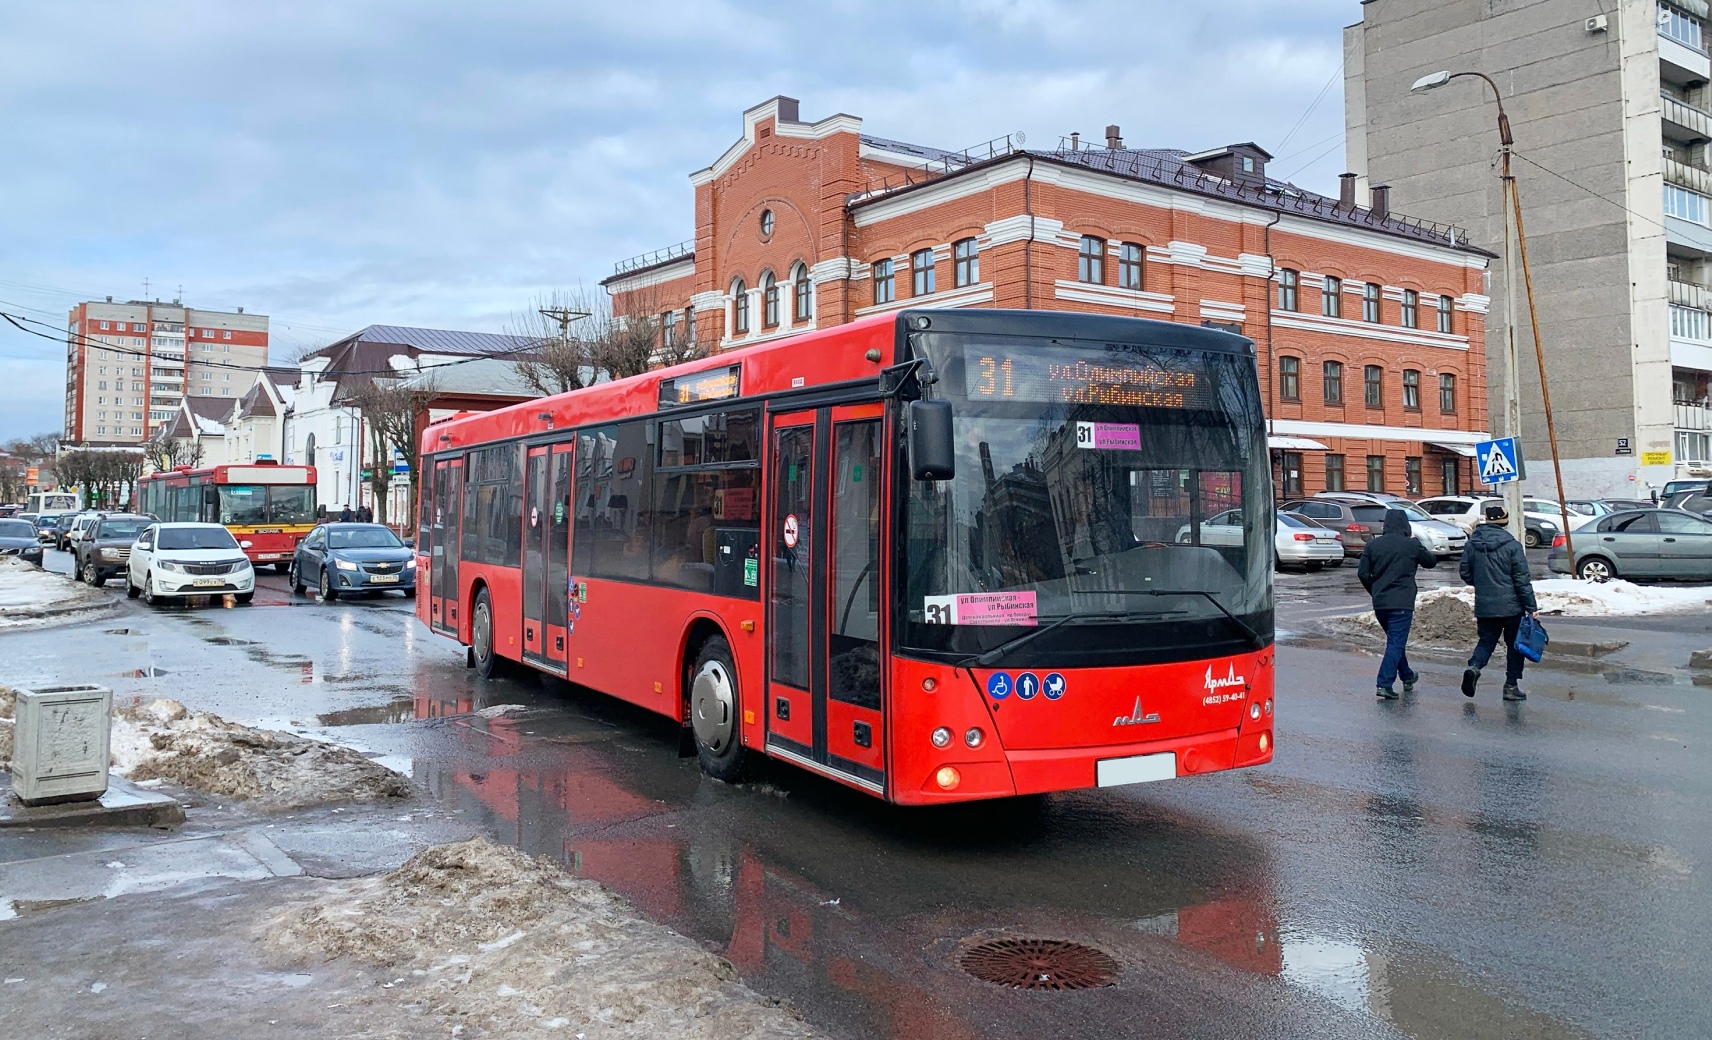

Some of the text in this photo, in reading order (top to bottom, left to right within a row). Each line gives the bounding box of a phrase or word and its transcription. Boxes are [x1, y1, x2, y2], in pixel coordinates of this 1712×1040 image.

[979, 357, 1014, 396] 31
[679, 383, 690, 402] 31
[1078, 426, 1092, 443] 31
[714, 496, 723, 515] 31
[926, 604, 951, 625] 31
[1202, 691, 1245, 706] (4852) 59-40-41
